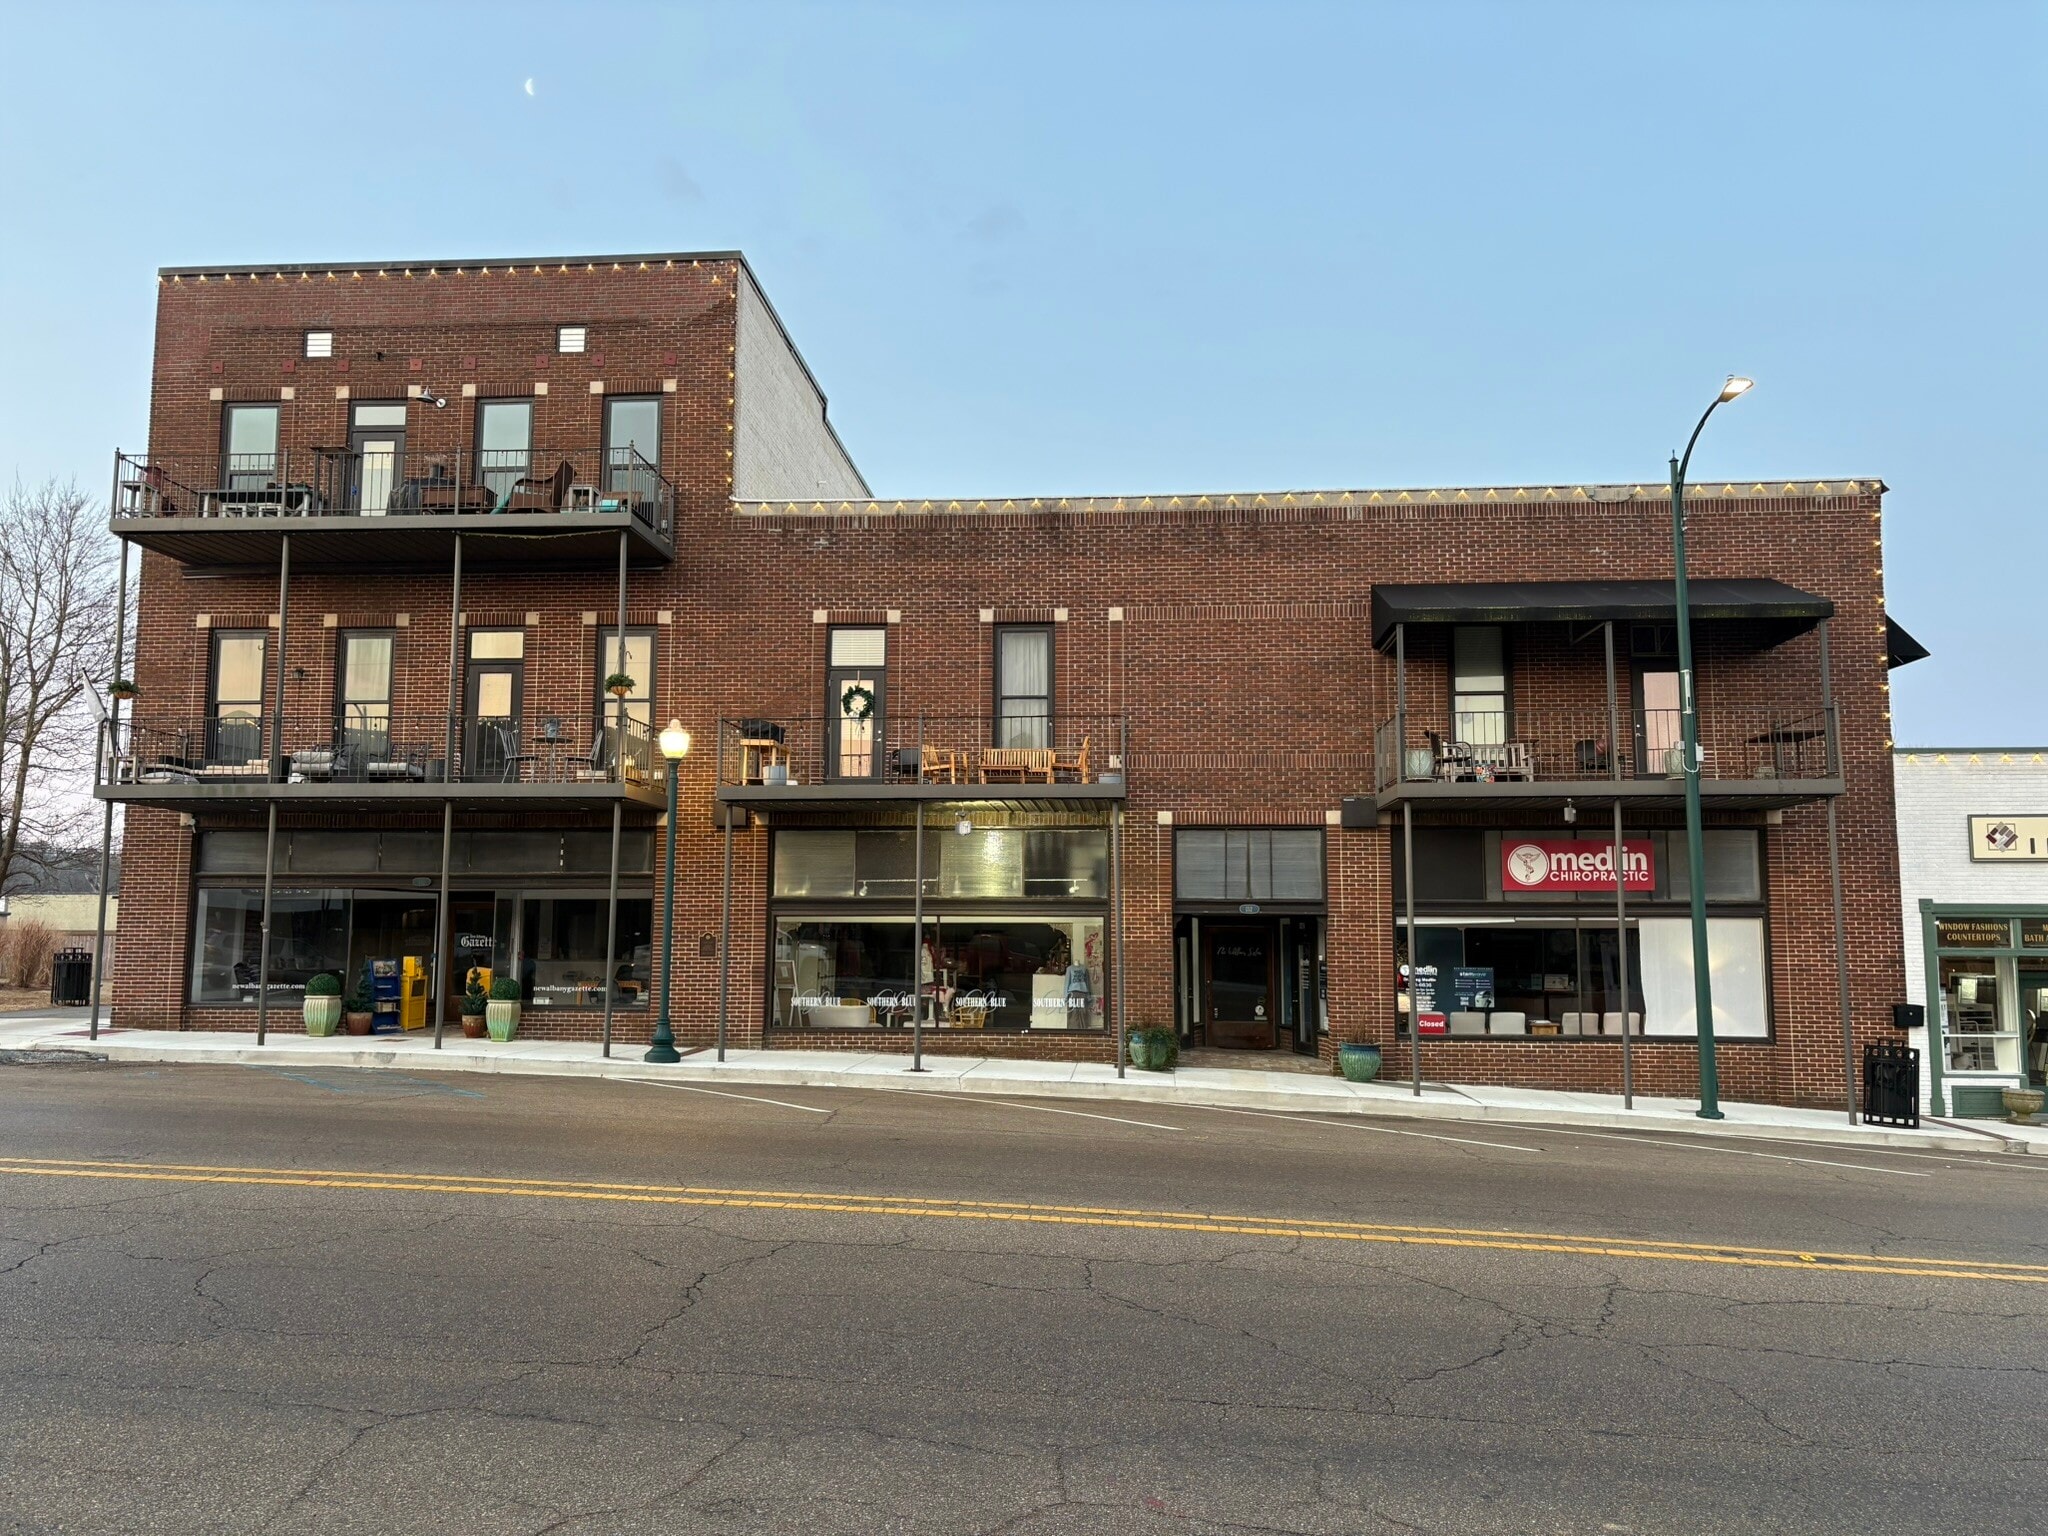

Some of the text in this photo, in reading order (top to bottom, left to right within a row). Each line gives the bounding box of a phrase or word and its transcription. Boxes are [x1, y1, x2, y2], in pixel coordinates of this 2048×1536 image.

[1938, 923, 2008, 931] WINDOW FASHIONS
[461, 935, 497, 948] Gazett
[1946, 932, 2001, 941] COUNTERTOPS
[2024, 934, 2044, 942] BATH
[231, 982, 306, 991] newalbangazette.com
[790, 996, 841, 1007] SOUTHERN BLUE
[866, 996, 898, 1007] SOUTHERN
[955, 997, 1007, 1008] SOUTHERN BLUE
[1032, 997, 1085, 1008] SOUTHERN BLUE
[1419, 1020, 1444, 1028] Closed
